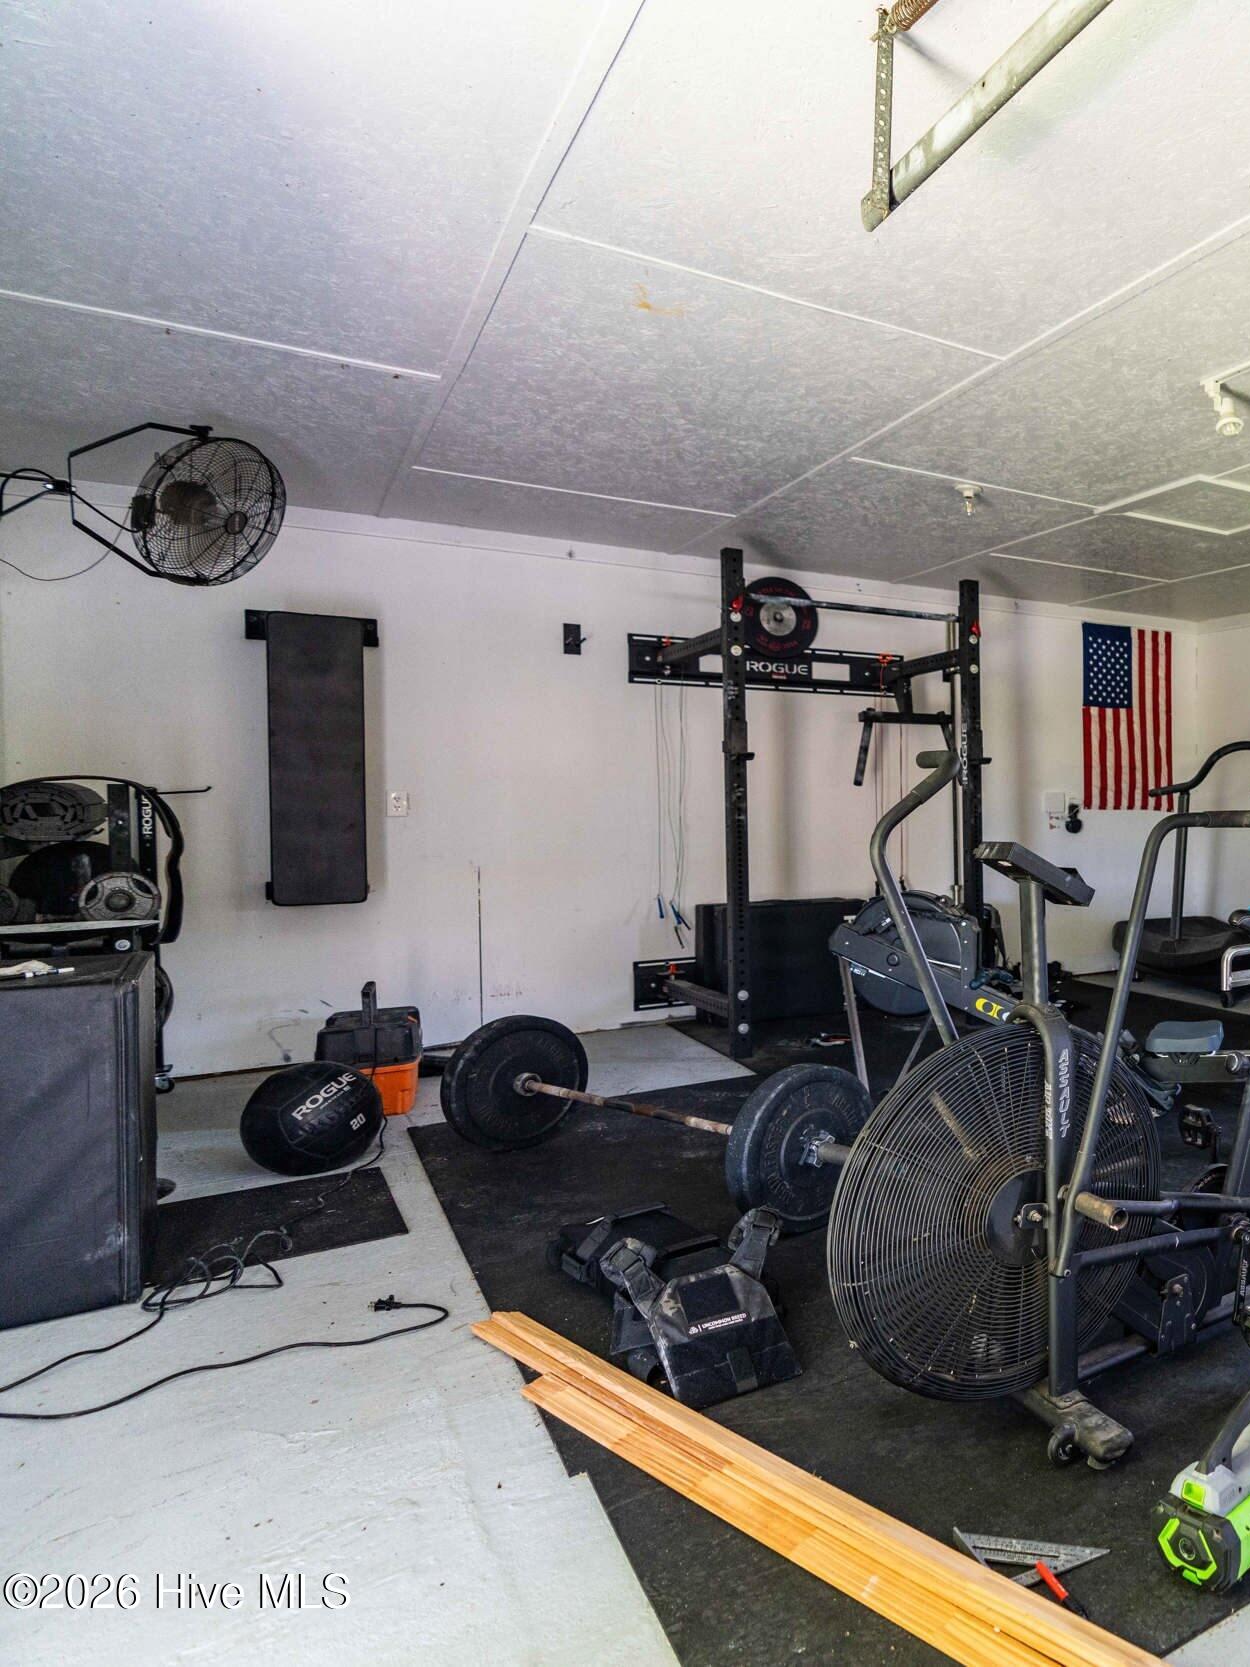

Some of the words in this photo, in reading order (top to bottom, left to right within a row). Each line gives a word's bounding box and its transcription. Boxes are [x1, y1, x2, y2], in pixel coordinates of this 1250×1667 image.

[745, 661, 809, 676] ROGUE
[141, 795, 153, 835] ROGU
[291, 1072, 357, 1121] ROGUE
[1058, 1047, 1071, 1139] ASSAULT
[349, 1113, 366, 1131] 20
